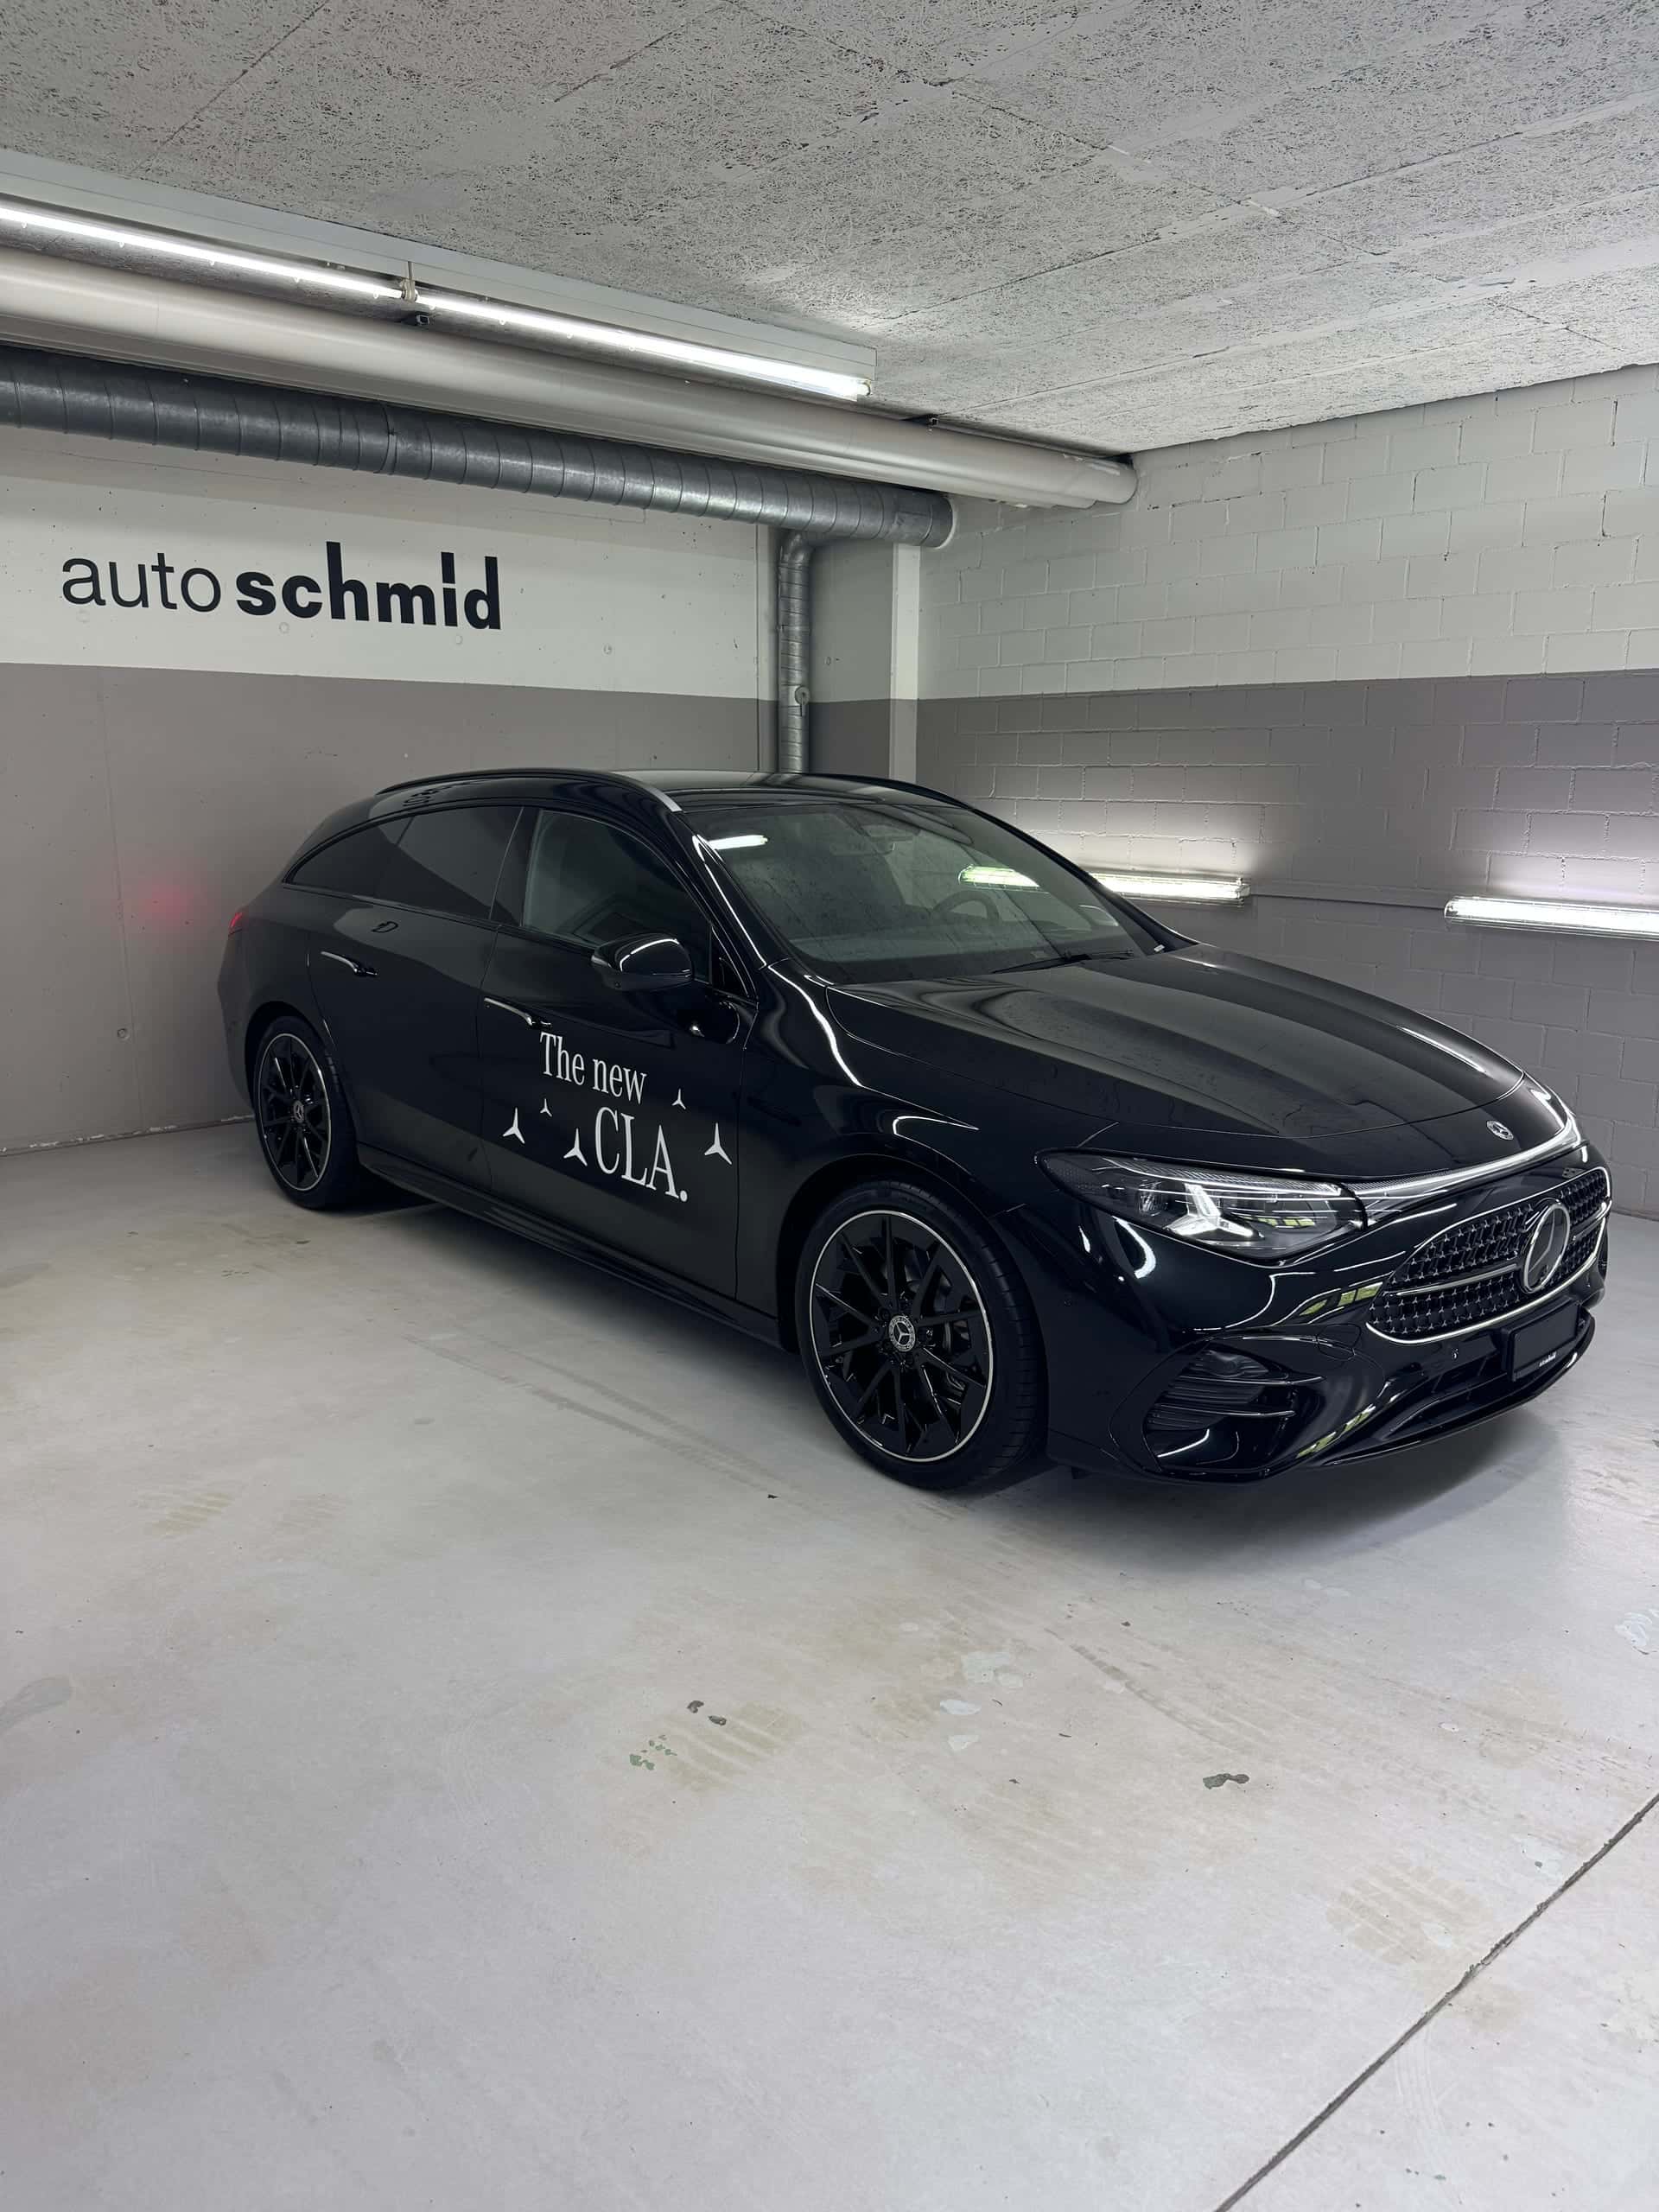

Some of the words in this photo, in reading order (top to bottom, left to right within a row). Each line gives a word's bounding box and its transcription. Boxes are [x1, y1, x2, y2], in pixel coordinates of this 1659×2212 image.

[61, 552, 221, 613] auto
[236, 541, 501, 630] schmid
[540, 1032, 585, 1085] The
[592, 1058, 647, 1104] new
[594, 1107, 688, 1202] CLA.
